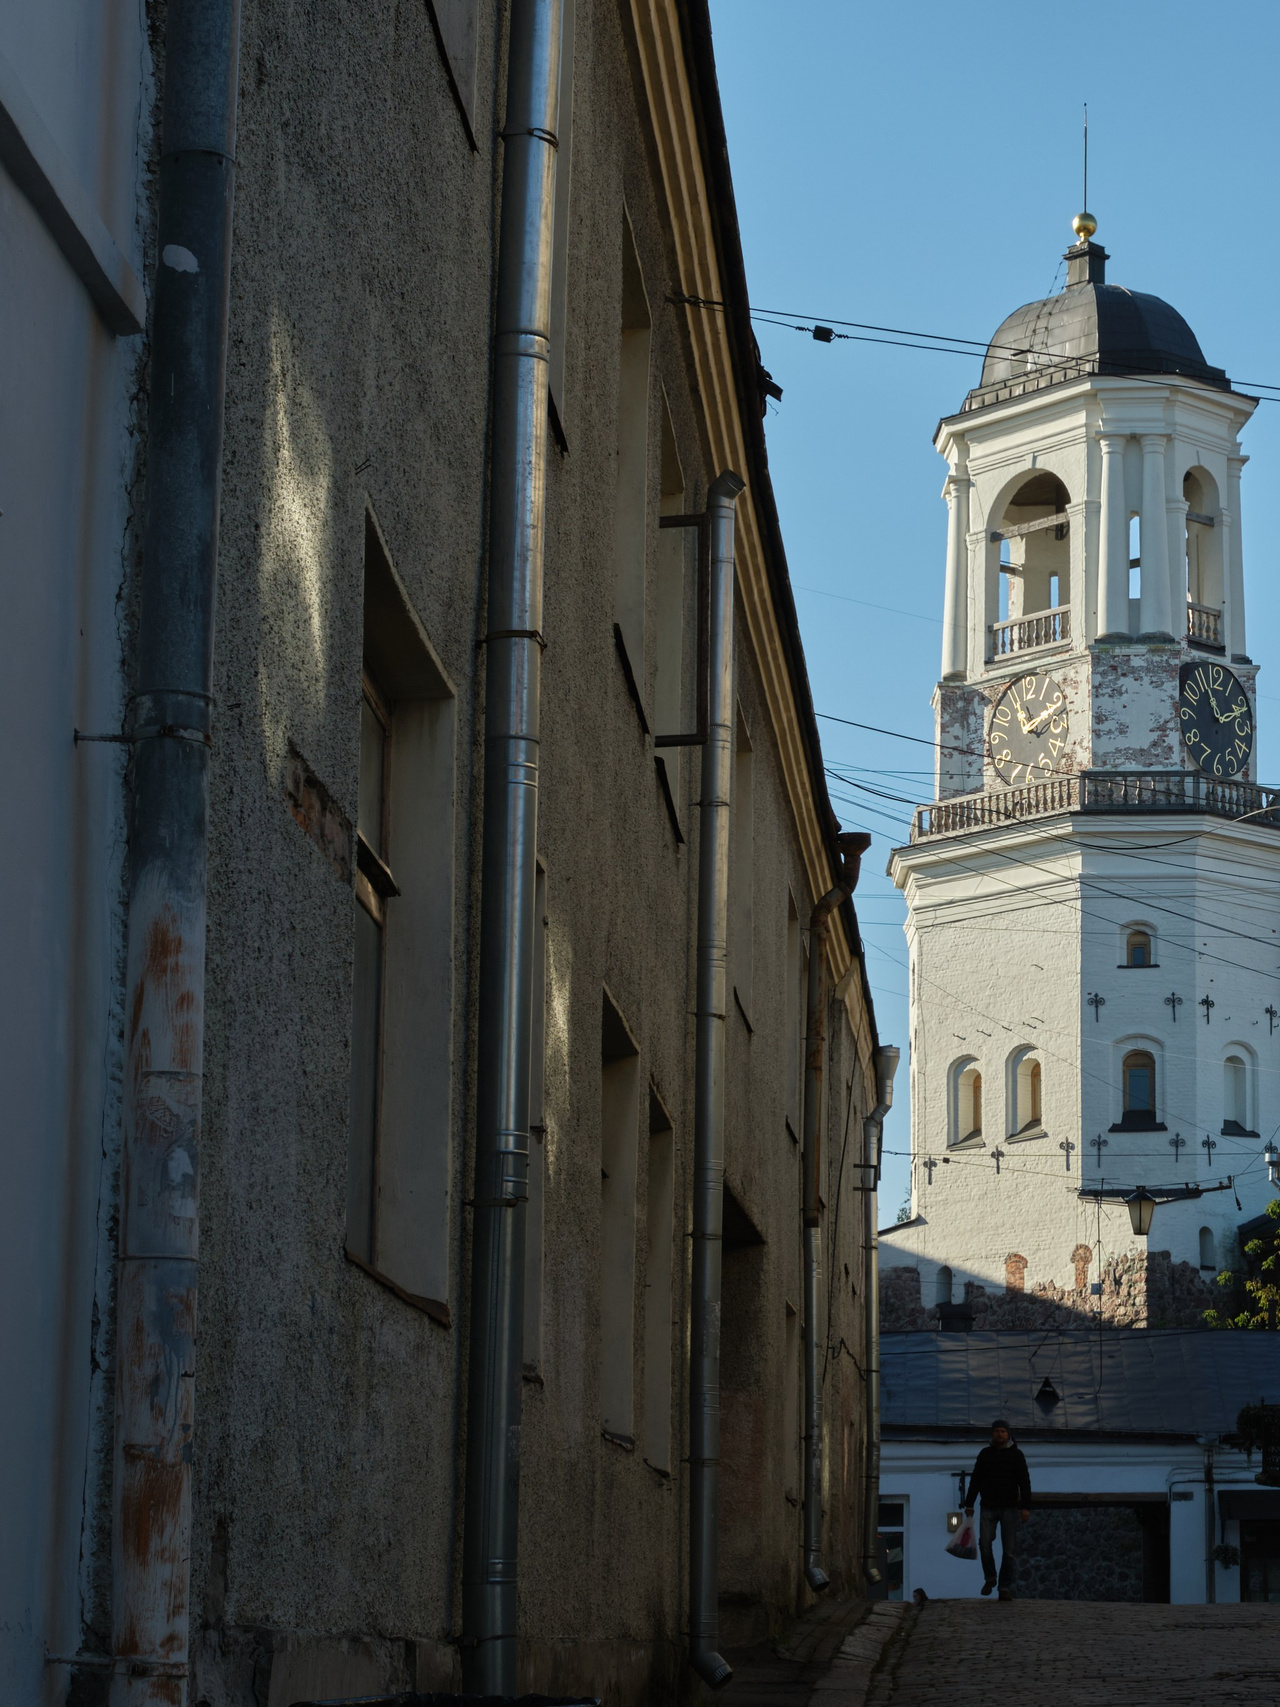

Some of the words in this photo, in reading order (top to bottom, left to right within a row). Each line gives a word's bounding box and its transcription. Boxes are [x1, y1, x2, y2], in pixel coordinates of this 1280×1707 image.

[1022, 676, 1036, 701] 12
[1194, 667, 1209, 693] 11
[1209, 664, 1223, 691] 12
[1225, 677, 1234, 696] 1
[1007, 685, 1022, 709] 11
[1039, 677, 1050, 701] 1
[1183, 680, 1200, 706] 10
[1046, 692, 1063, 714] 2
[1180, 706, 1197, 720] 9
[1231, 695, 1248, 714] 2
[992, 705, 1012, 727] 10
[1050, 714, 1068, 734] 3
[1234, 718, 1251, 736] 3
[990, 731, 1008, 745] 9
[1048, 737, 1065, 758] 4
[1185, 728, 1200, 745] 8
[995, 749, 1012, 769] 8
[1199, 742, 1212, 766] 7
[1234, 738, 1250, 759] 4
[1038, 753, 1053, 777] 5
[1213, 753, 1223, 776] 6
[1225, 747, 1237, 774] 5
[1010, 760, 1023, 784] 7
[1025, 762, 1035, 784] 6
